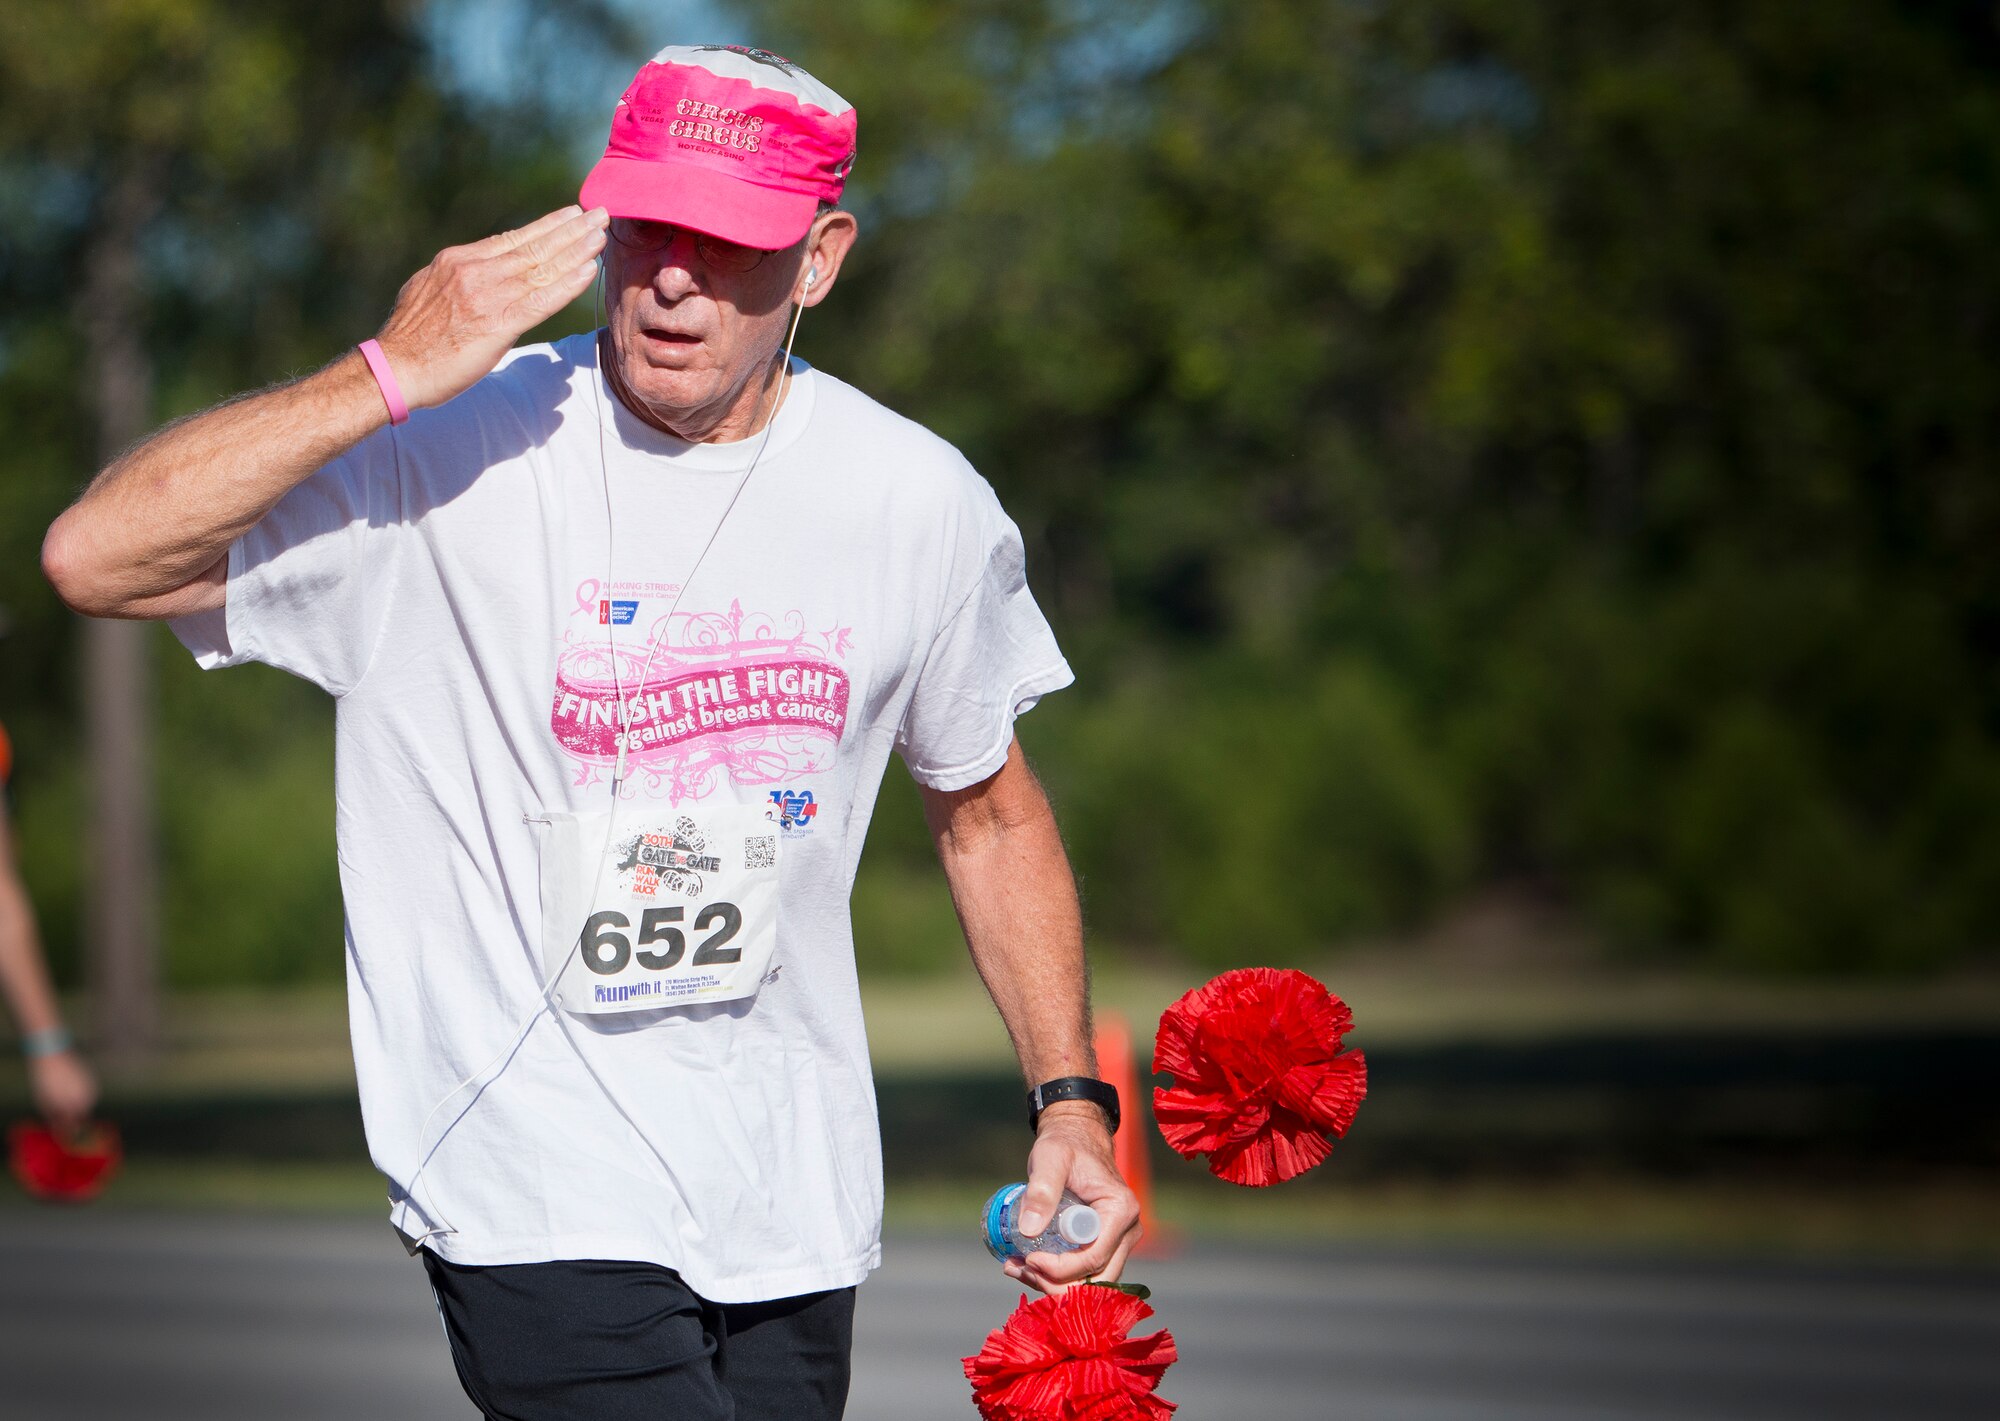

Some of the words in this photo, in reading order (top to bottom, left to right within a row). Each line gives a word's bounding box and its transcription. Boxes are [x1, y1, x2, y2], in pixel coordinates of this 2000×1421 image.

[676, 98, 764, 132] CIRCUS
[669, 119, 762, 153] CIRCUS
[768, 137, 789, 149] RENO
[677, 142, 745, 162] HOTEL/CASINO
[631, 591, 654, 599] Breast
[644, 582, 681, 592] STRIDES
[676, 674, 740, 711] THE
[747, 668, 843, 701] FIGHT
[698, 699, 771, 727] breast
[776, 701, 844, 728] cancer
[642, 833, 674, 847] 30TH
[641, 847, 677, 866] GATE
[686, 853, 721, 872] GATE
[636, 865, 656, 876] RUN
[635, 875, 661, 887] WALK
[633, 884, 657, 896] RUCK
[581, 902, 742, 975] 652
[629, 982, 651, 997] with
[654, 980, 661, 994] it
